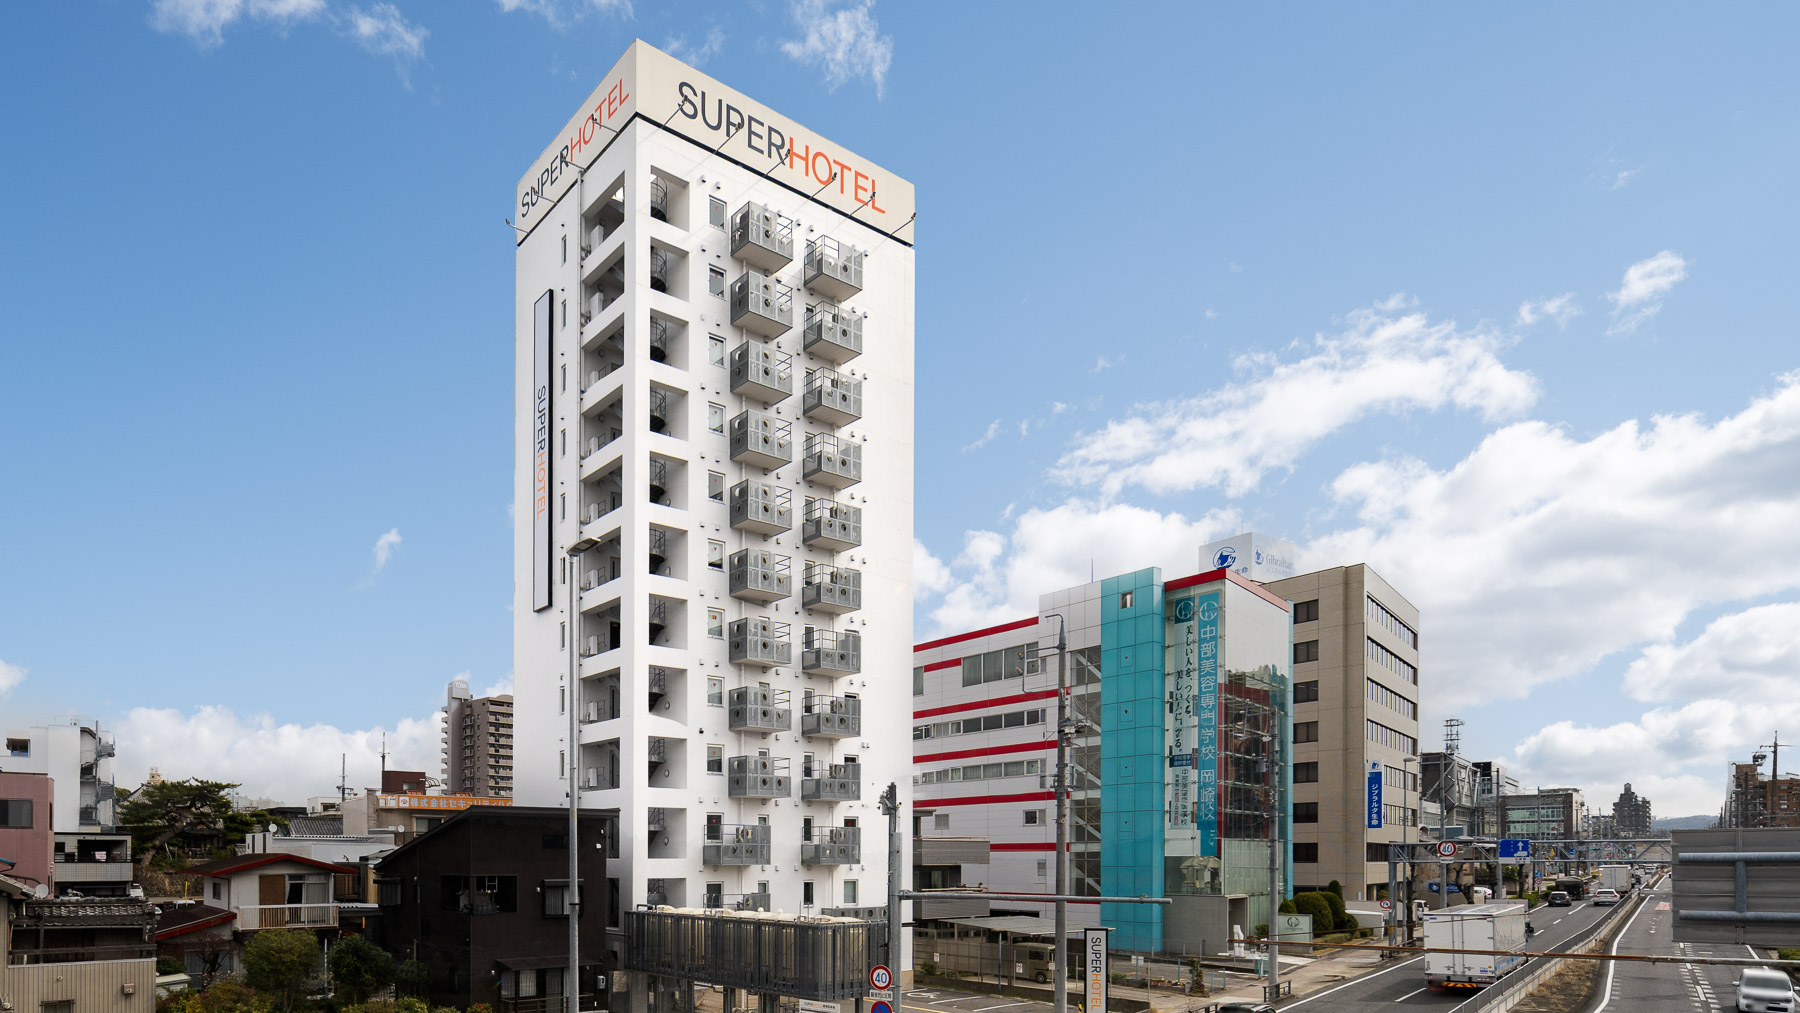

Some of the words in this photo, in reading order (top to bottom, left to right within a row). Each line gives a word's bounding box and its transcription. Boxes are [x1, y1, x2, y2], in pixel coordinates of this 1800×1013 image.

[521, 78, 630, 219] SUPERHOTEL
[678, 81, 886, 214] SUPERHOTEL
[536, 385, 547, 521] SUPERHOTEL
[1266, 553, 1293, 570] Gibraltar
[1200, 625, 1216, 760] 中部美容専門学校
[1200, 769, 1215, 820] 岡崎校
[1371, 784, 1379, 826] ジブラルタ生命
[1442, 845, 1453, 853] 40
[875, 973, 887, 984] 40
[1091, 937, 1102, 1011] SUPERHOTEL
